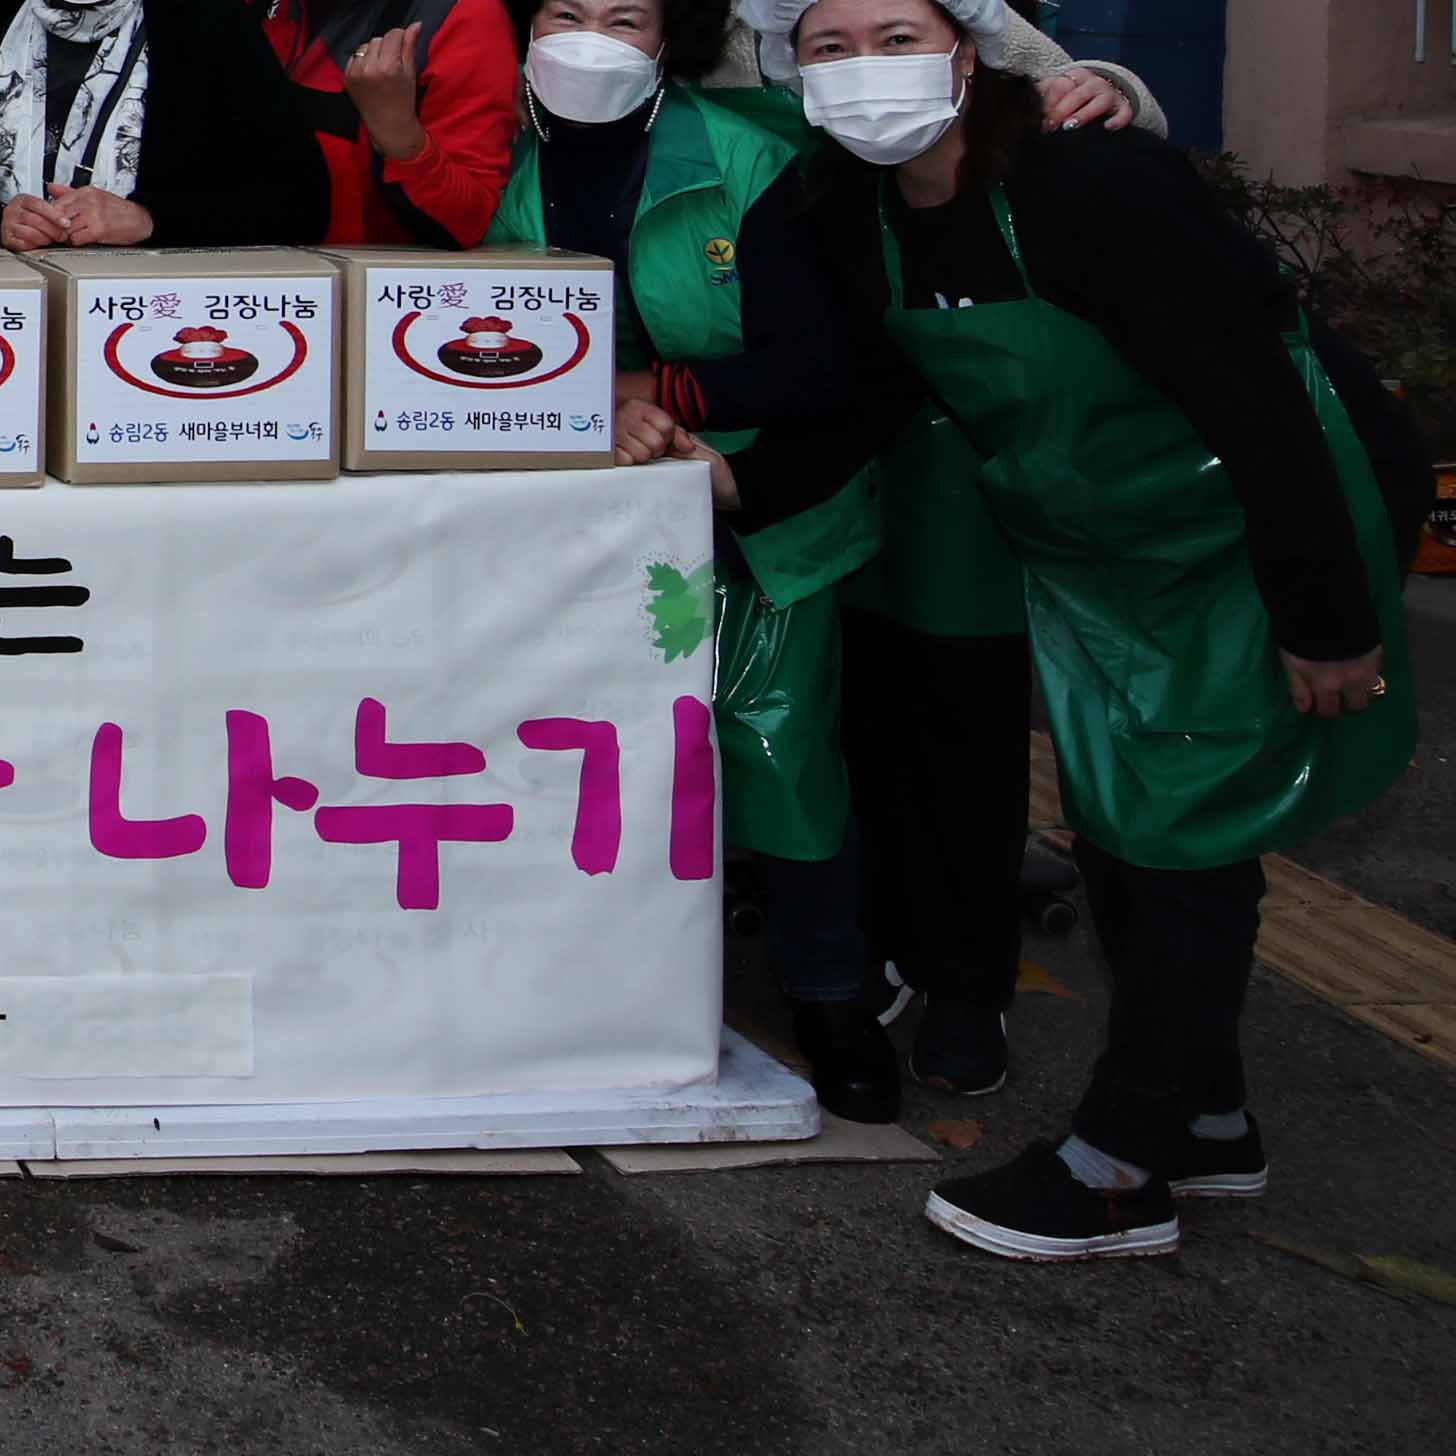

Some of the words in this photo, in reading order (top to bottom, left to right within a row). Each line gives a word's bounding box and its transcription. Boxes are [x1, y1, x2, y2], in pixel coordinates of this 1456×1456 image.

[89, 293, 182, 321] 사랑愛
[205, 295, 318, 320] 김장나눔
[378, 283, 469, 310] 사랑愛
[491, 286, 600, 311] 김장나눔
[109, 423, 168, 443] 송림2동
[179, 421, 278, 442] 새마을부녀회
[396, 411, 455, 431] 송림2동
[464, 412, 561, 431] 새마을부녀회
[89, 696, 714, 910] 나누기
